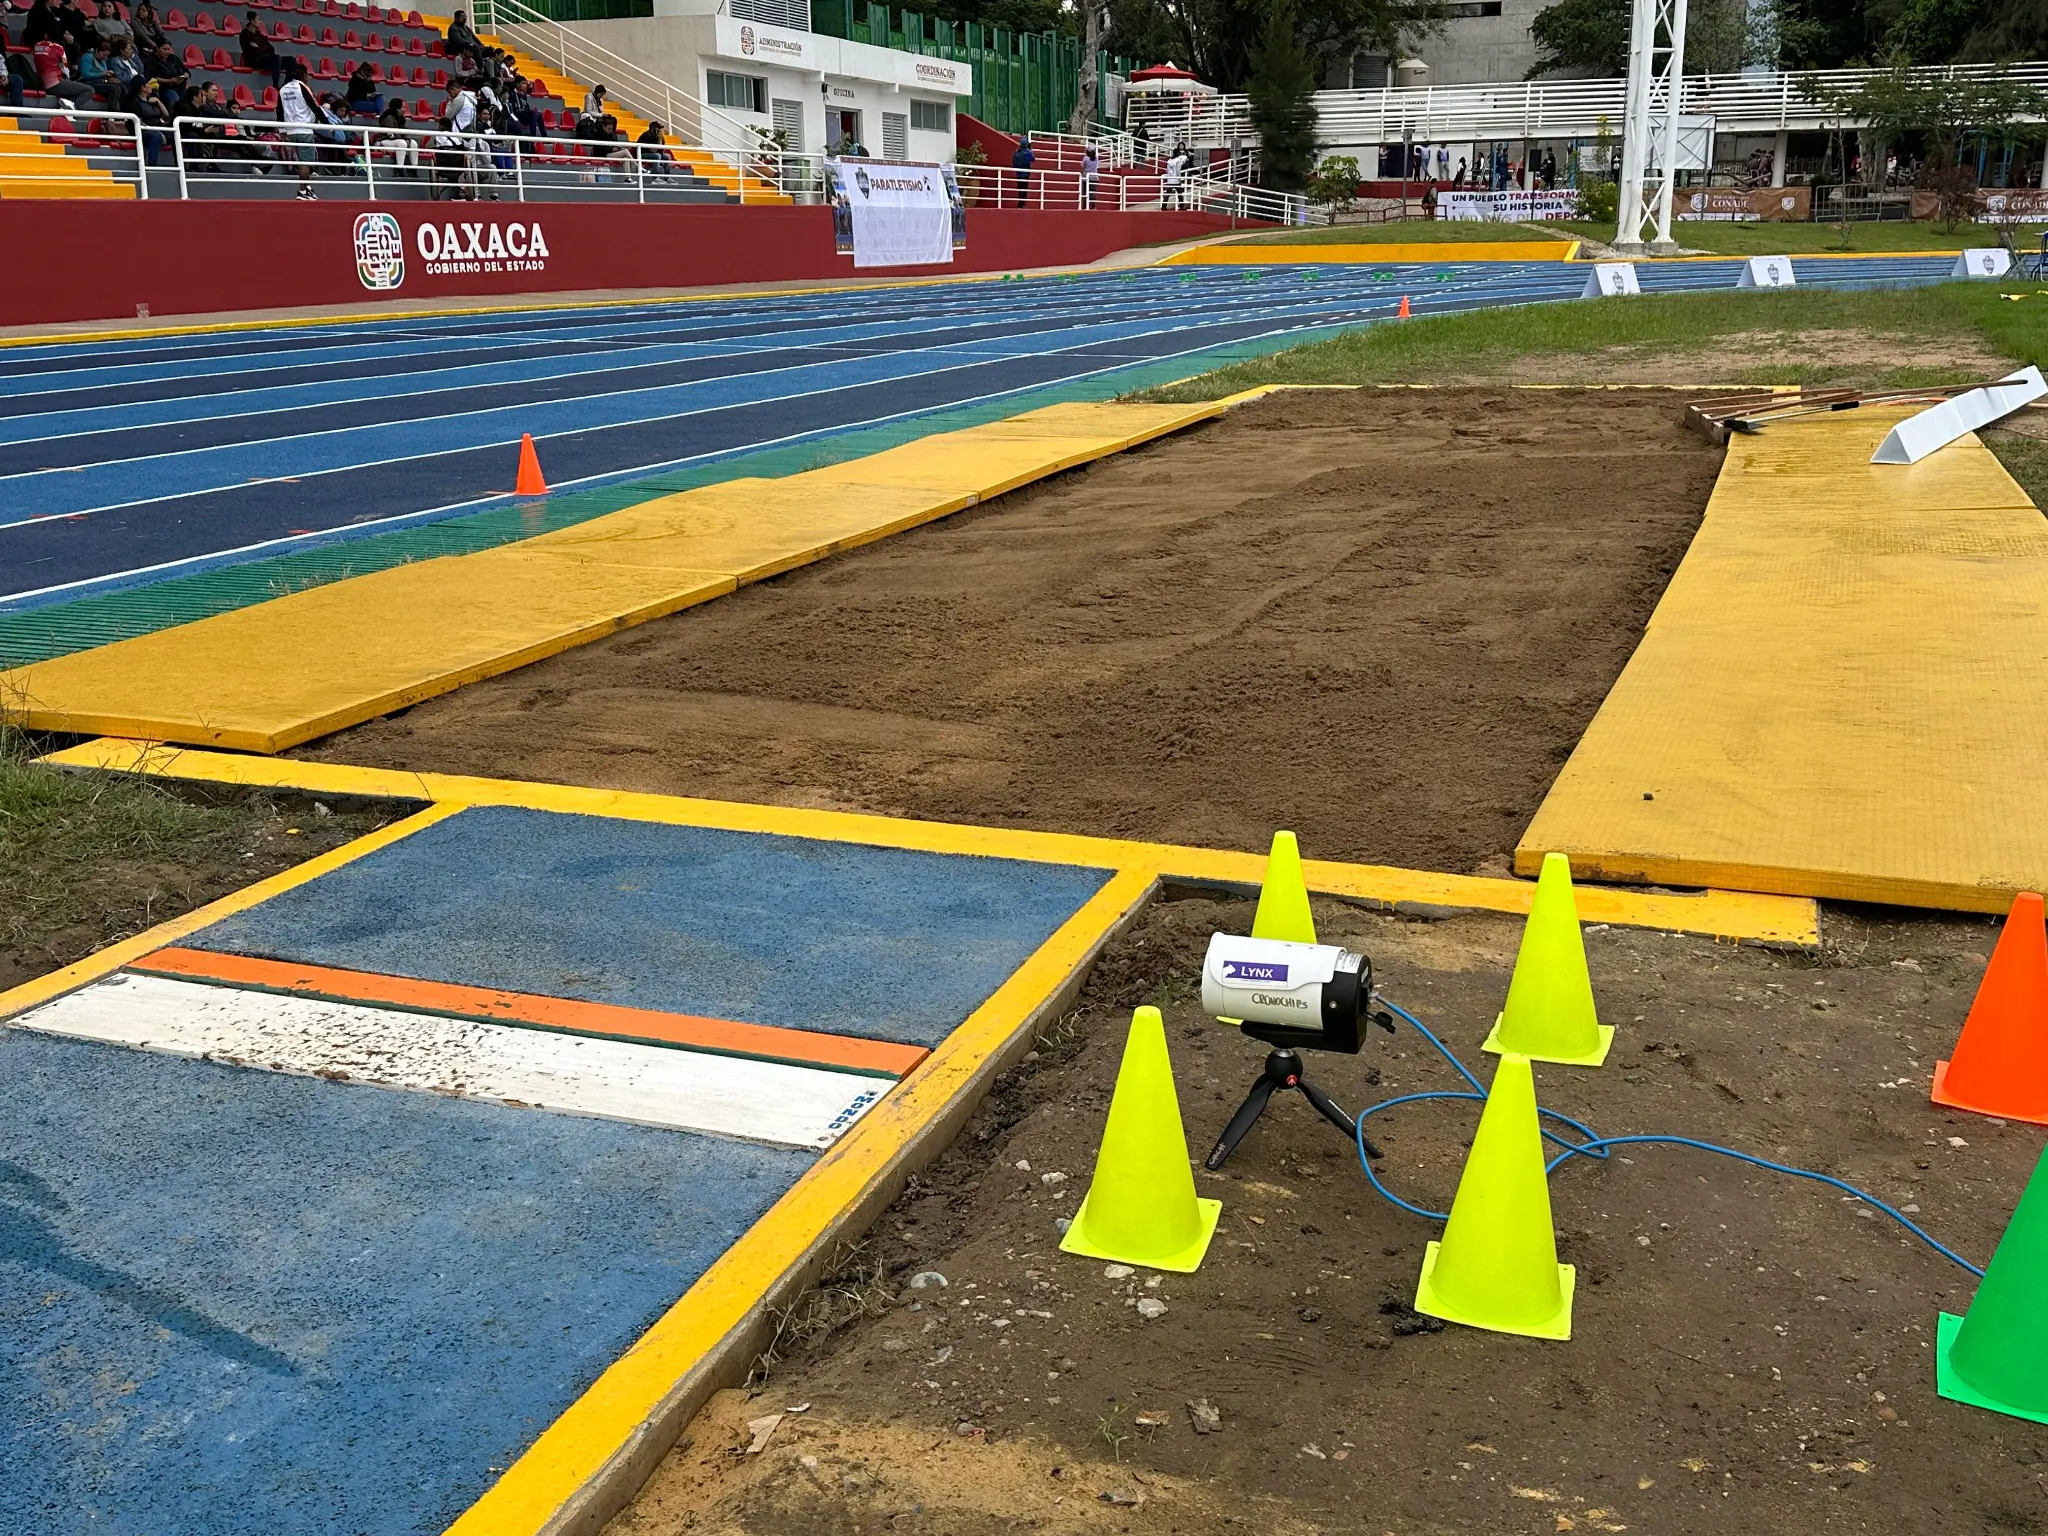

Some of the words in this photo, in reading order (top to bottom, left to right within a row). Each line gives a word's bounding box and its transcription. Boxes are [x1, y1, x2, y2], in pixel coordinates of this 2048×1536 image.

[870, 178, 923, 192] PARATLETISMO
[1452, 194, 1466, 202] UN
[1468, 193, 1507, 202] PUEBLO
[1712, 199, 1749, 208] CONADE
[1493, 203, 1507, 212] SU
[417, 222, 549, 261] OAXACA
[426, 262, 480, 275] GOBIERNO
[484, 261, 503, 272] DEL
[507, 260, 545, 271] ESTADO
[1240, 965, 1274, 979] LYNX
[828, 1095, 875, 1130] MONDO
